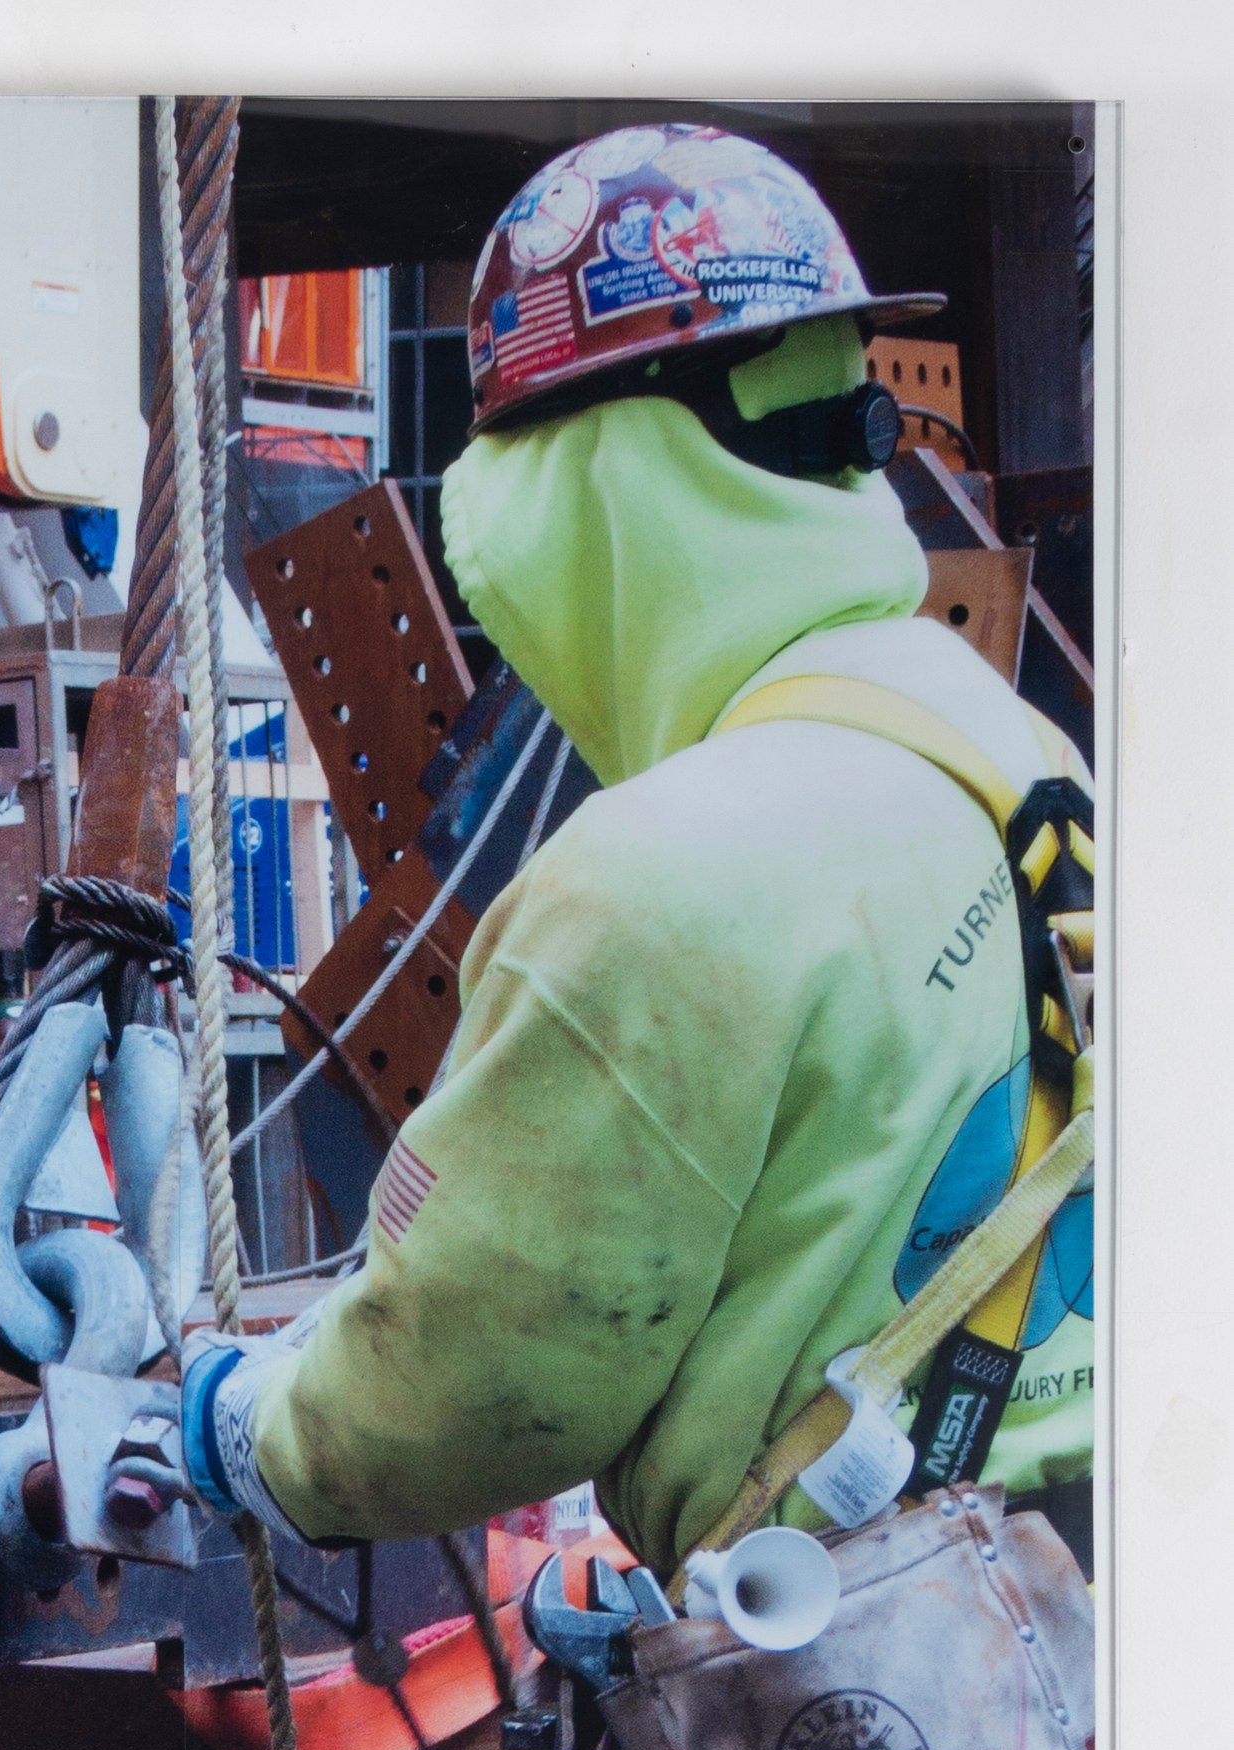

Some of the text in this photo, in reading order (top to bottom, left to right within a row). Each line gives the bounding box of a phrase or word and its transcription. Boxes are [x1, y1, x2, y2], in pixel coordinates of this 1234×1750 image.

[620, 260, 659, 279] IRONW
[698, 260, 817, 282] ROCKEFELLER
[708, 283, 814, 303] UNIVERSITY
[925, 860, 1015, 993] TURNE
[910, 1219, 978, 1252] Capa
[1010, 1375, 1063, 1401] JURY
[925, 1393, 975, 1478] MSA
[955, 1439, 973, 1469] Safety
[967, 1394, 989, 1438] Company
